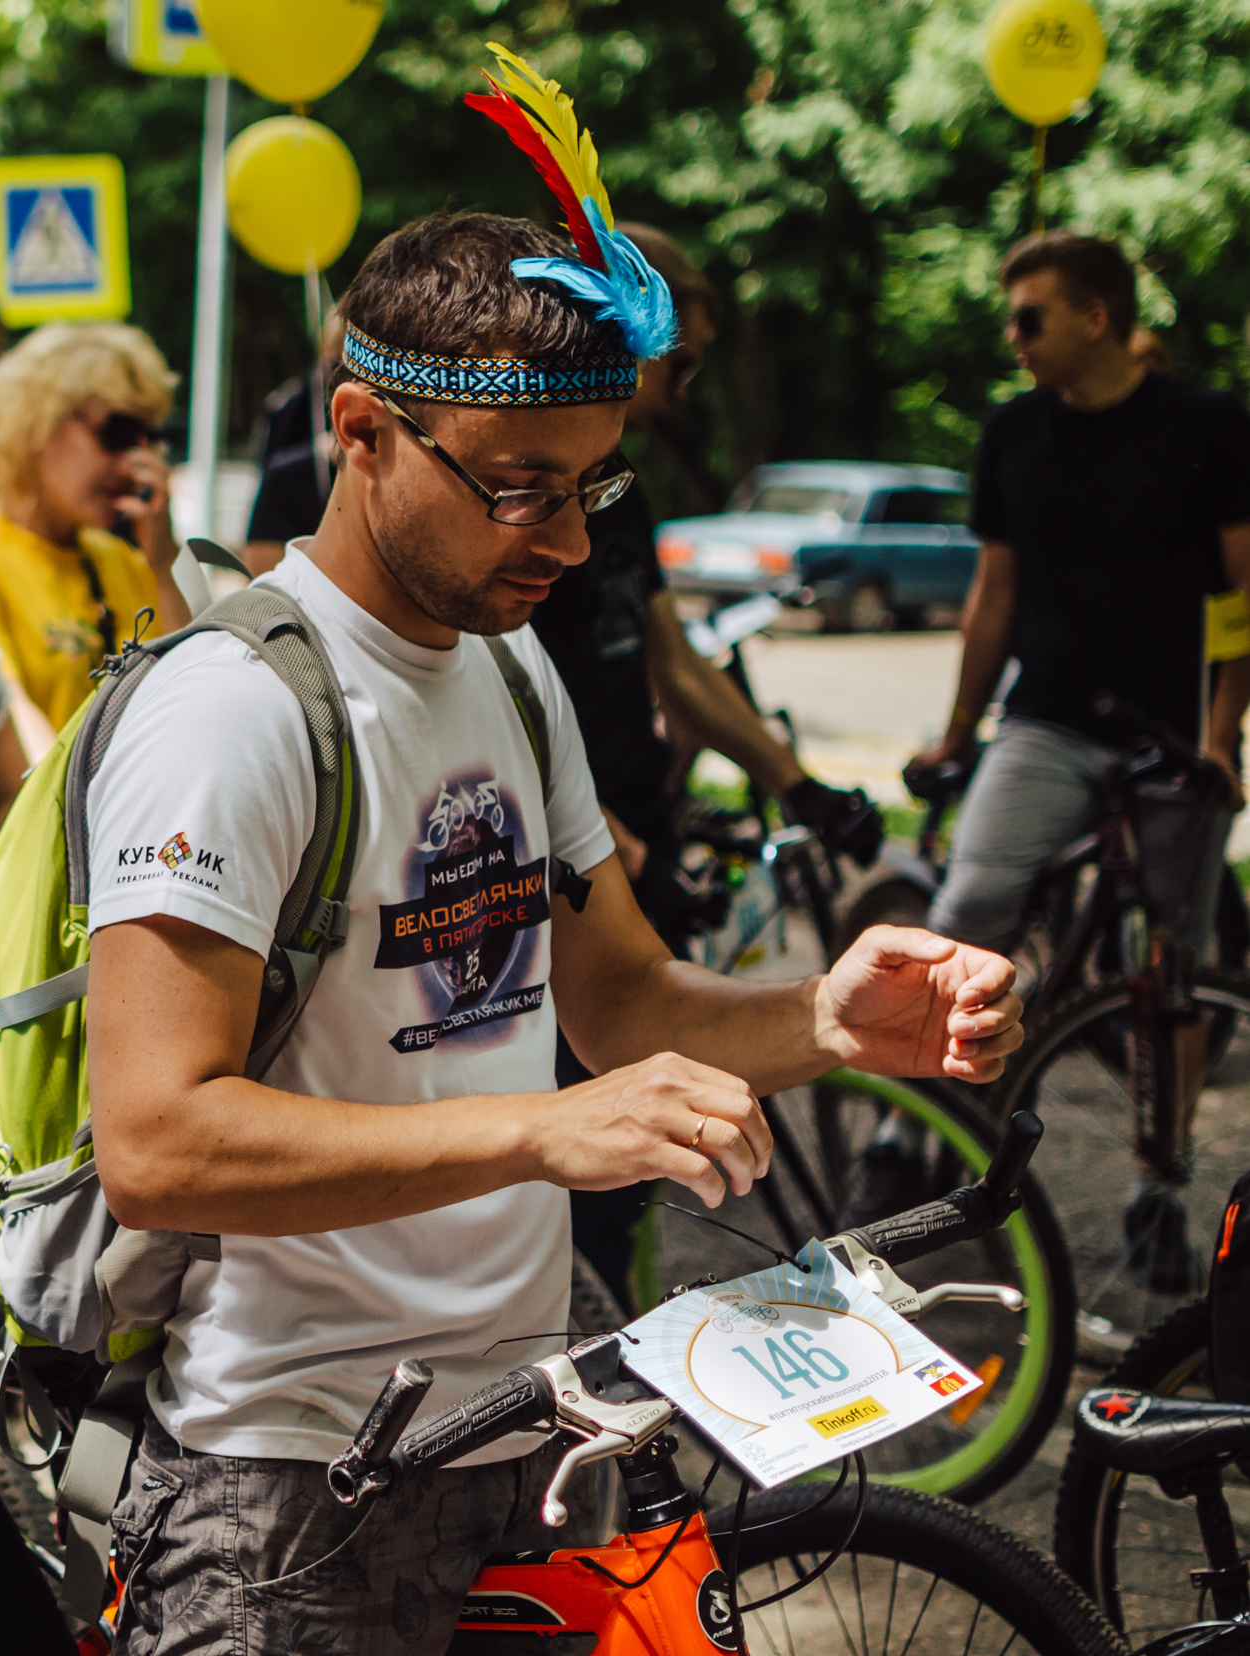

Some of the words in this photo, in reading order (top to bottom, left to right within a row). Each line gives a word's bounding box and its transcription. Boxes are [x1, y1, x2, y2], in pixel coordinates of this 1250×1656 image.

[118, 846, 155, 867] КУБ
[488, 849, 506, 866] НА
[172, 870, 220, 892] РЕКЛАМА
[423, 937, 433, 954] В
[439, 904, 529, 949] ПЯТИГОРСКЕ
[466, 948, 480, 980] 25
[891, 1297, 917, 1311] LIVIO
[730, 1329, 850, 1400] 146
[768, 1368, 889, 1422] #пятигорскийвелопарад2018
[626, 1408, 661, 1430] ALIVIO
[817, 1403, 879, 1432] Tinkoff.ru
